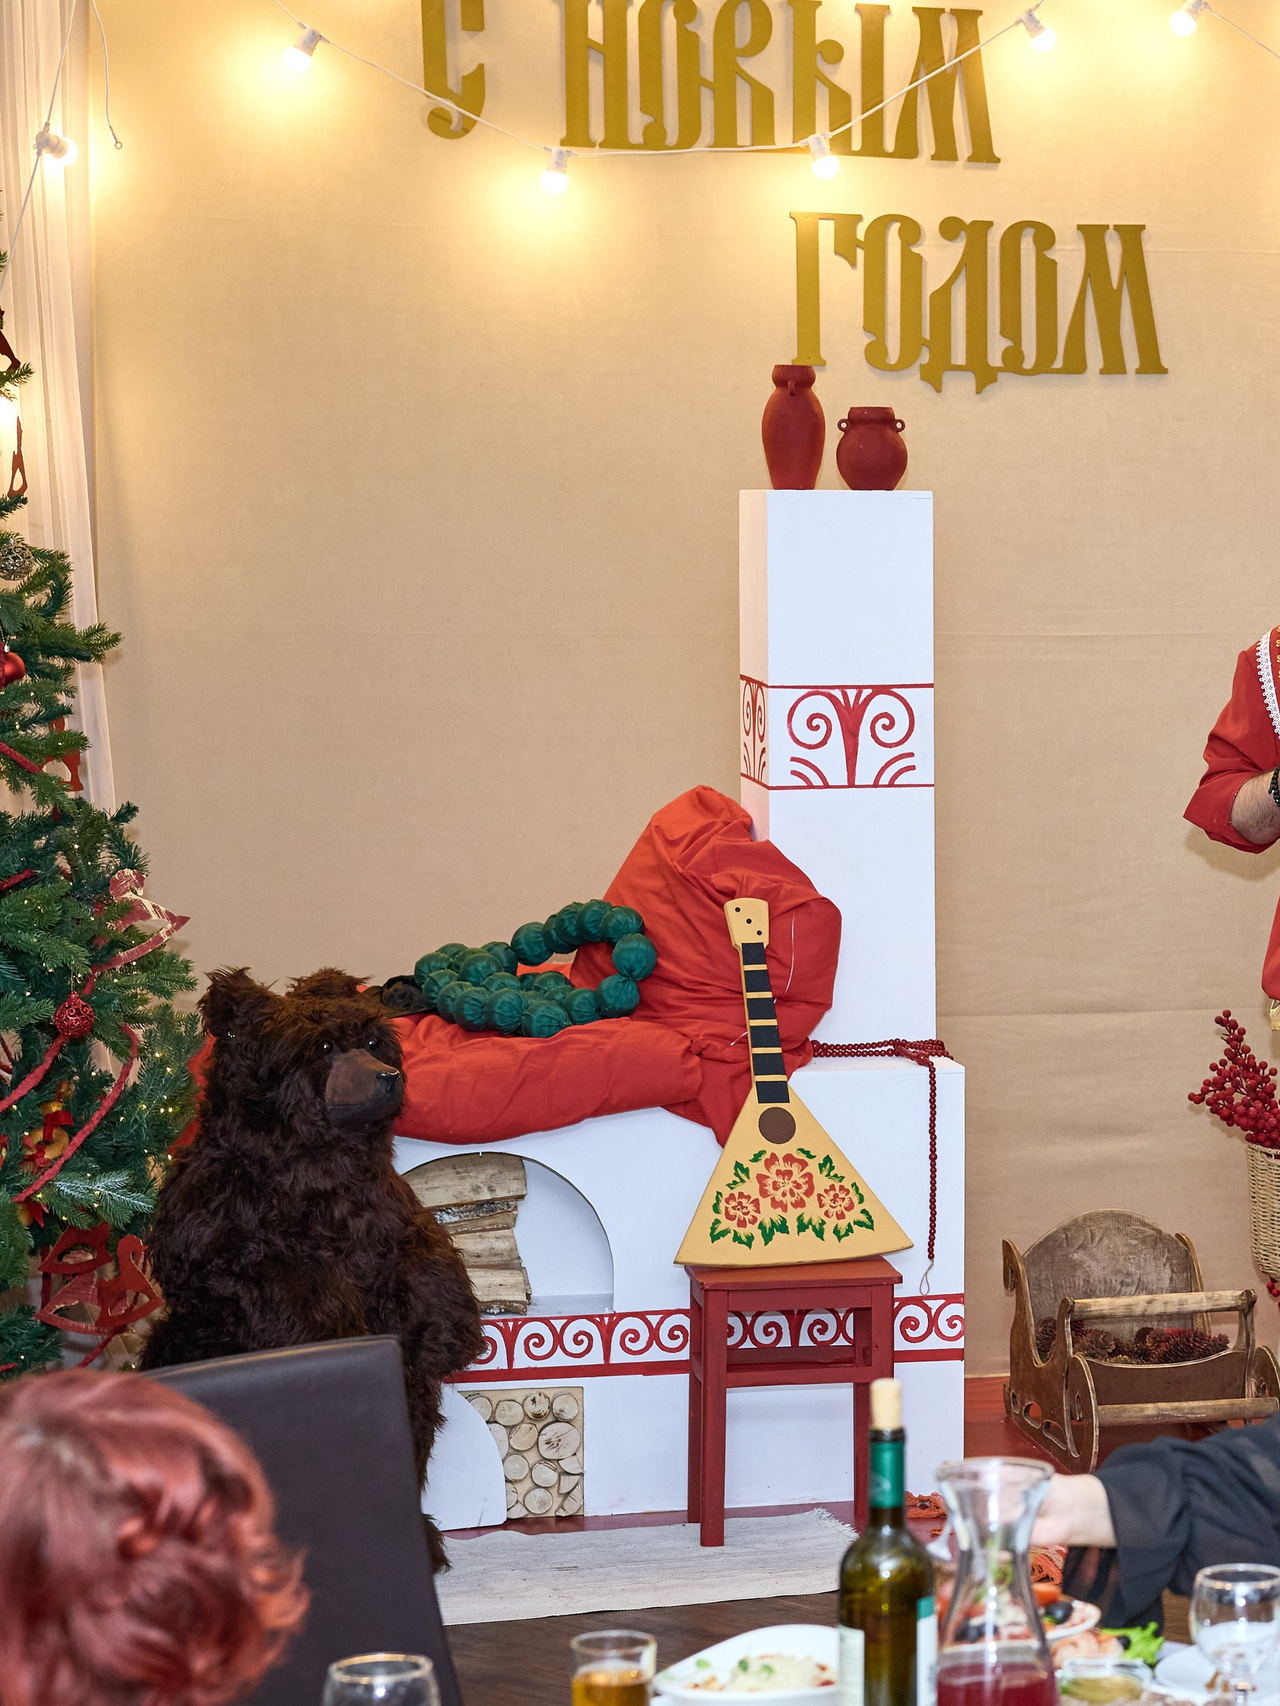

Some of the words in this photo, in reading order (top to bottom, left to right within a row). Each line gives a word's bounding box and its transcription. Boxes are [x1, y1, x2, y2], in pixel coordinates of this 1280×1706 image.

[421, 0, 486, 139] С
[560, 0, 1001, 164] НОВЫМ
[789, 211, 1168, 394] ГОДОМ
